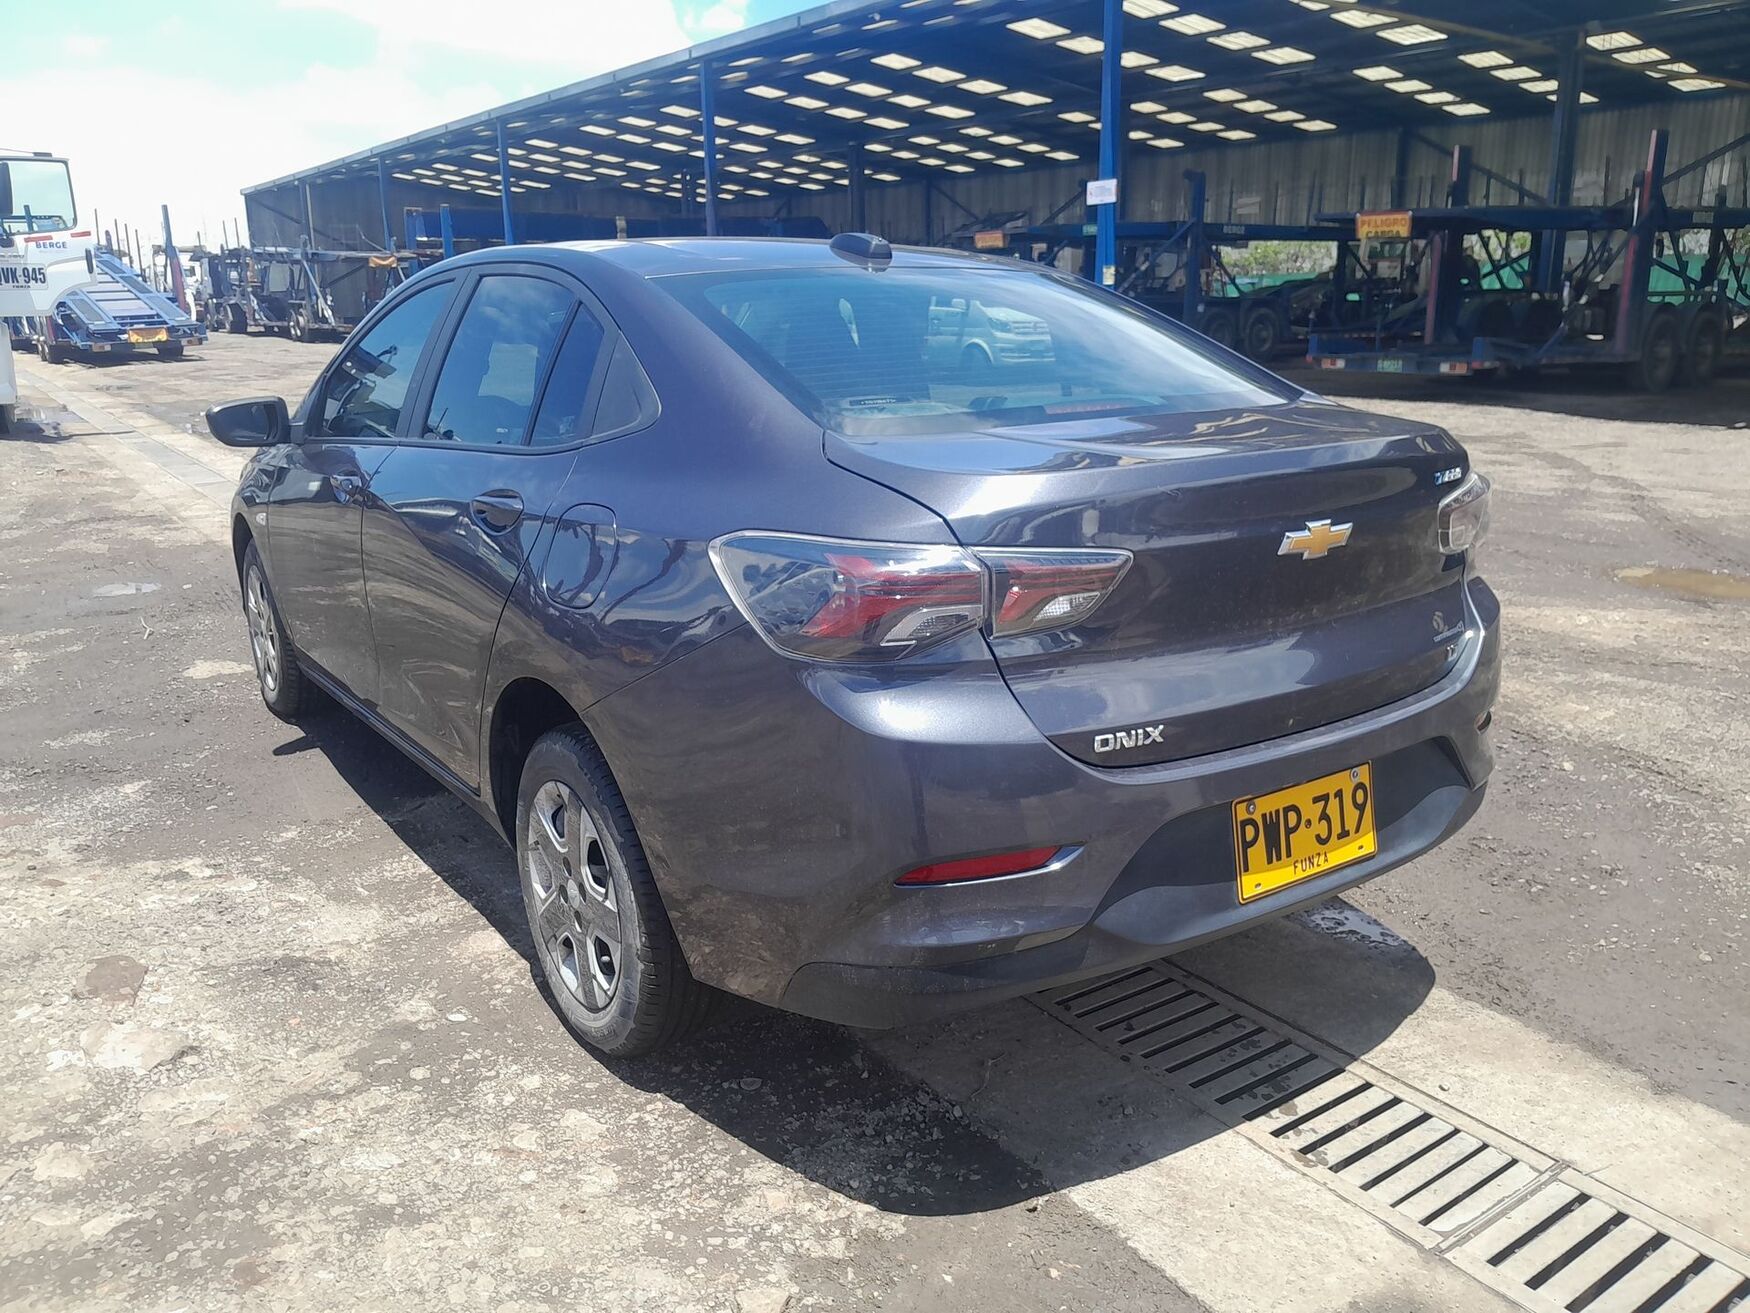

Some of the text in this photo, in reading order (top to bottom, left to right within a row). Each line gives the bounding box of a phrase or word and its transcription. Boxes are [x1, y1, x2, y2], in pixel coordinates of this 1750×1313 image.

[1360, 217, 1408, 228] PELIGRO
[35, 241, 67, 249] BERGE
[1094, 724, 1165, 753] ONIX
[1293, 850, 1329, 875] FUNZA
